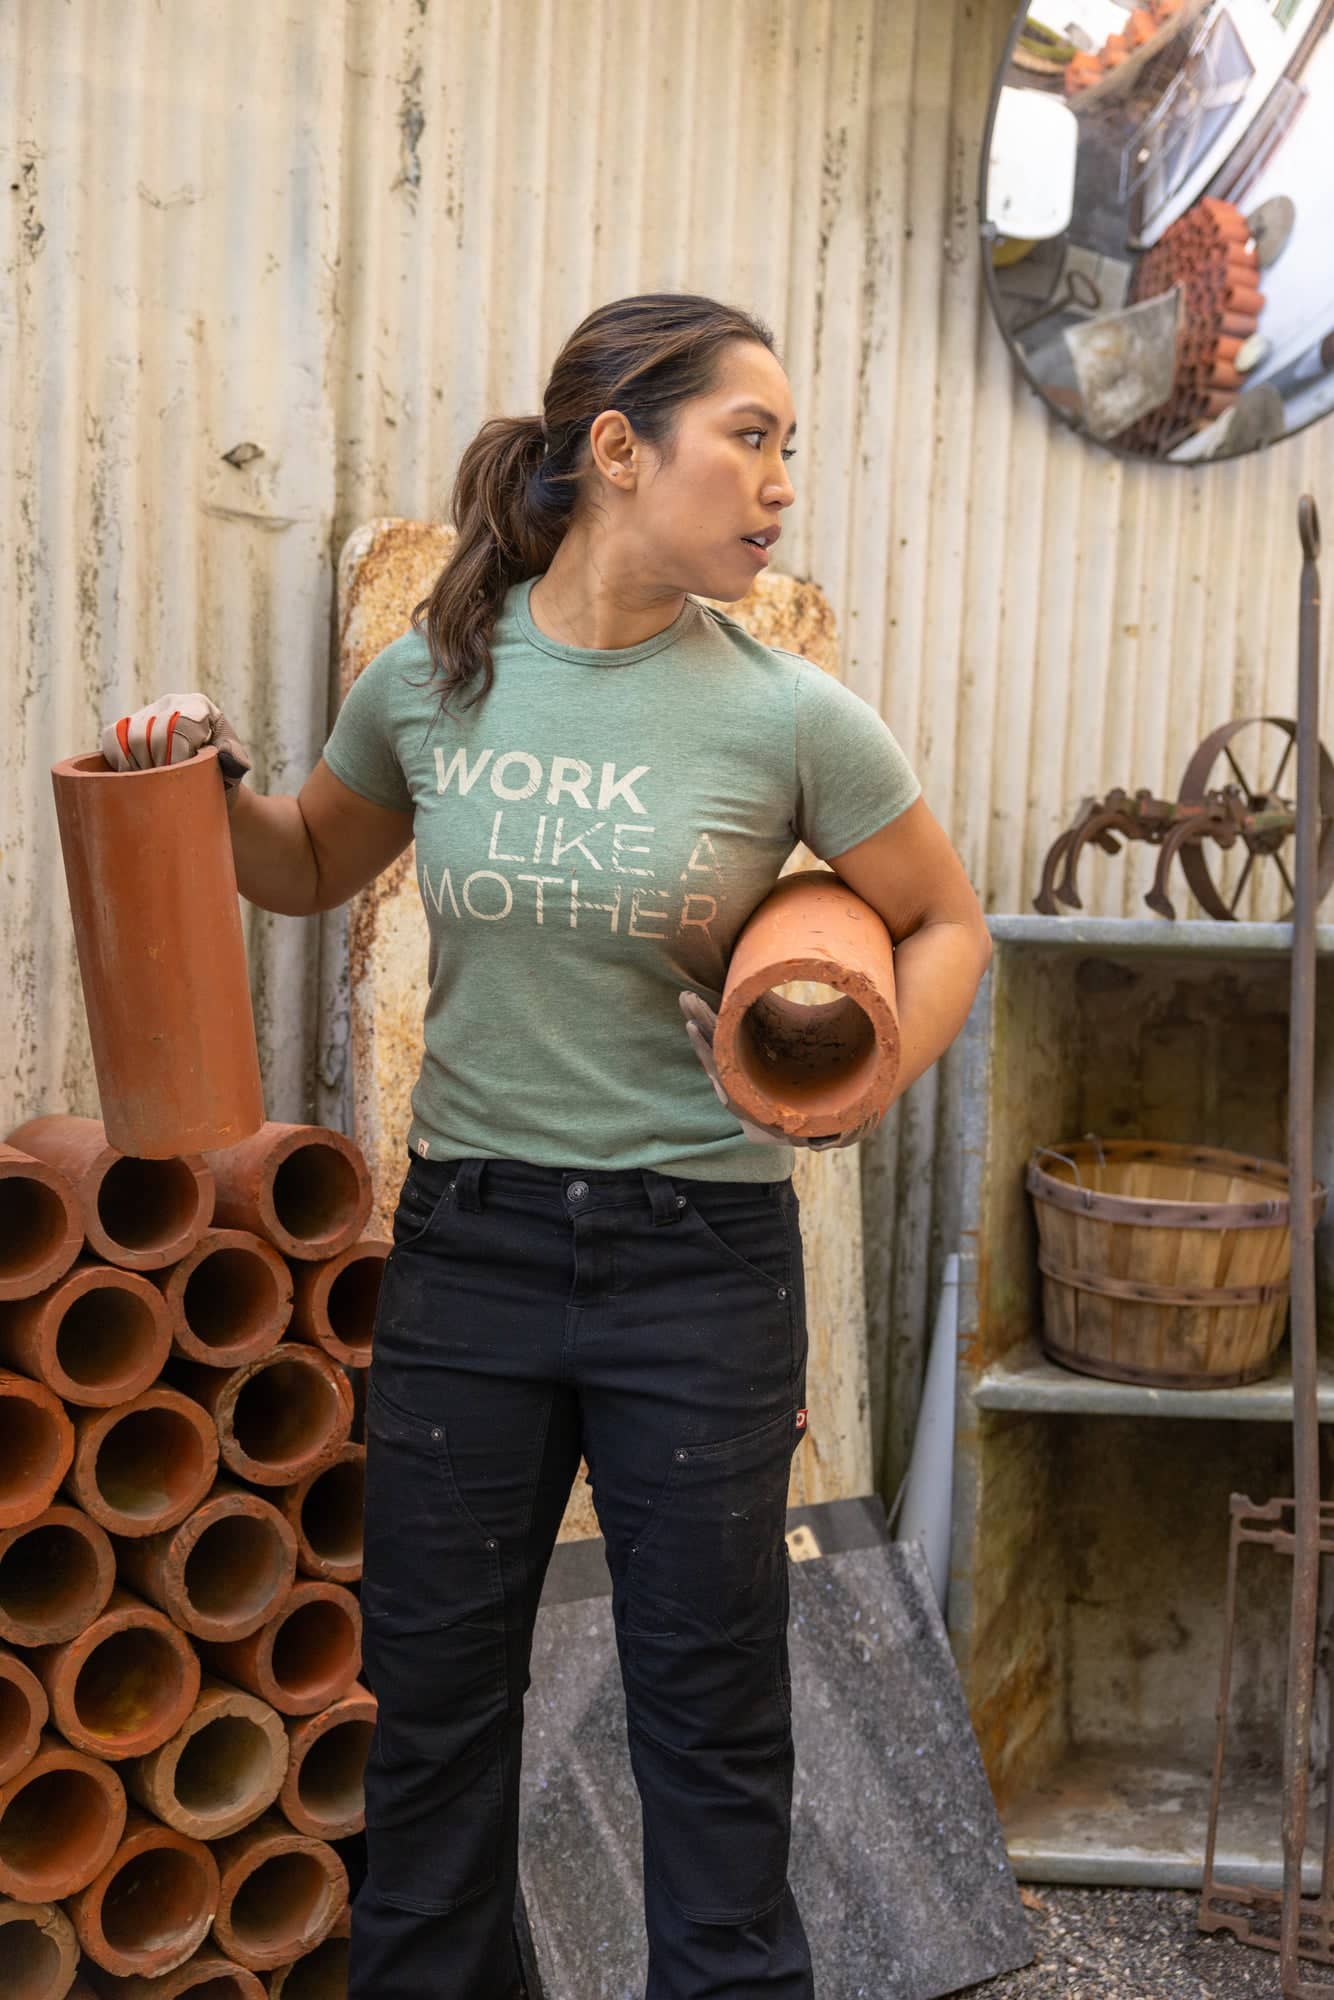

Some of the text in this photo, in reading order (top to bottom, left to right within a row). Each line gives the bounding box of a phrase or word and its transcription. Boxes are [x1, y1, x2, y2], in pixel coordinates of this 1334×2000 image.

[433, 747, 651, 814] WORK
[488, 810, 723, 881] LIKE A
[423, 864, 718, 943] MOTHER
